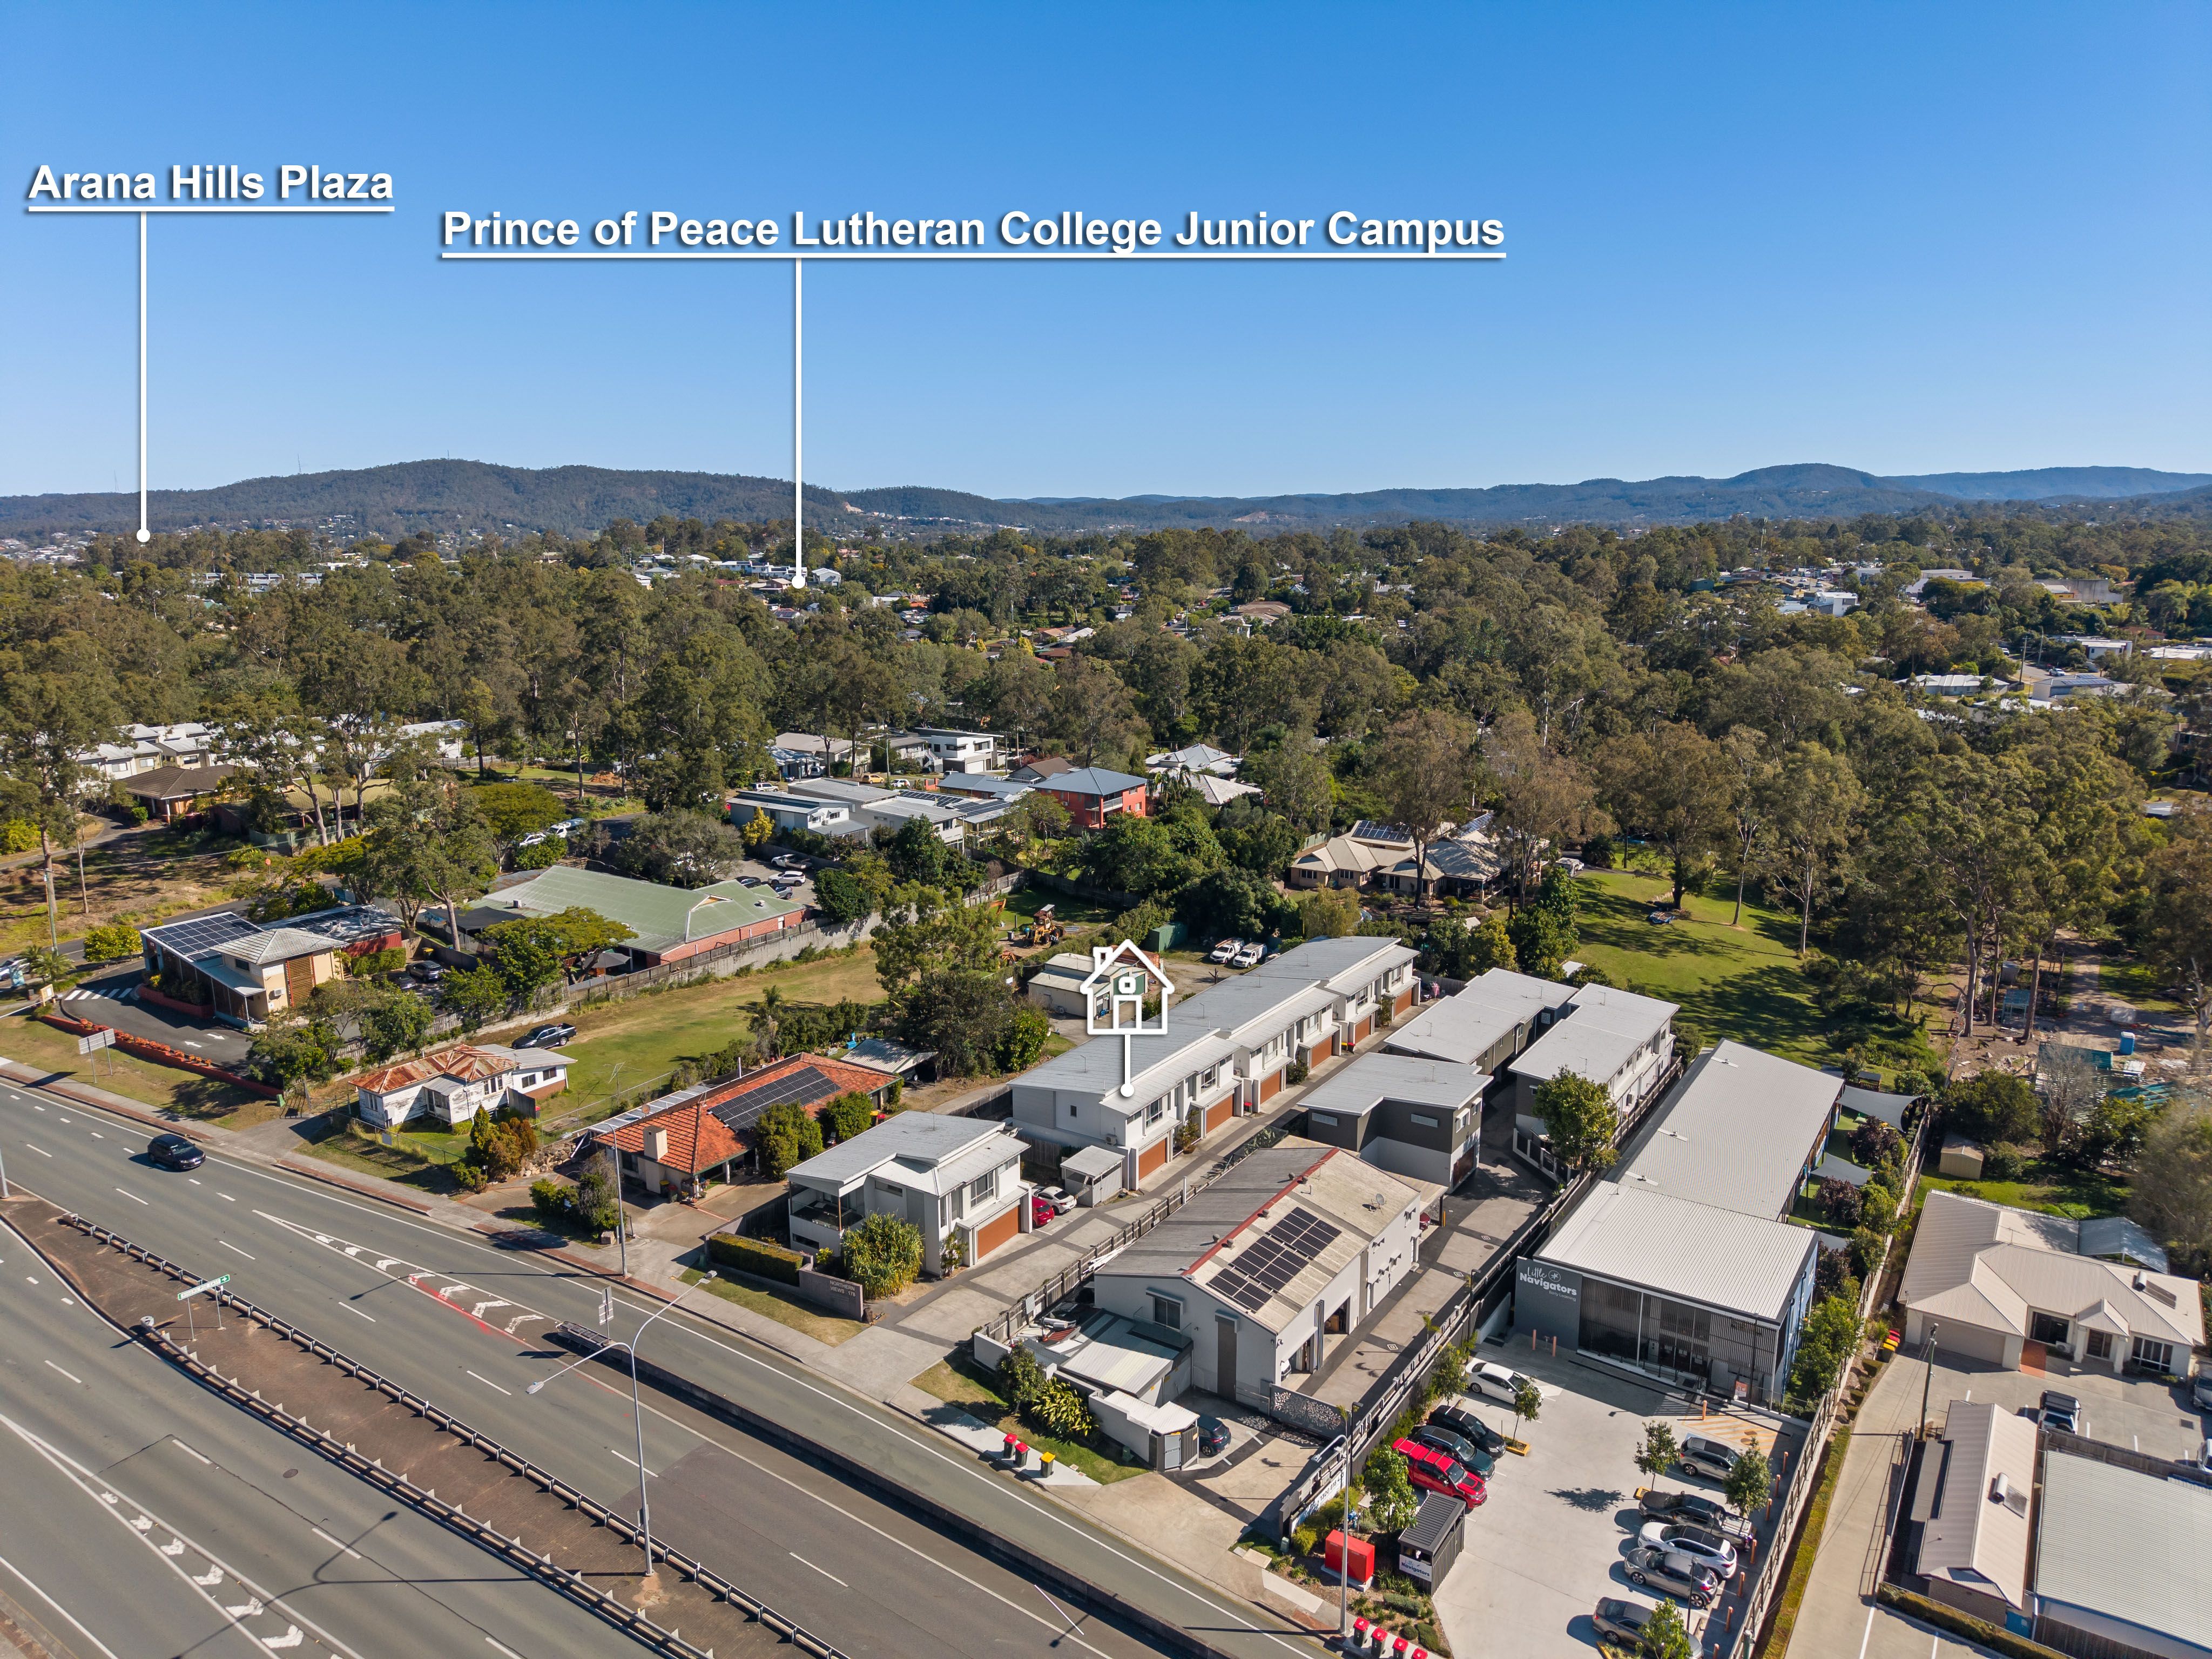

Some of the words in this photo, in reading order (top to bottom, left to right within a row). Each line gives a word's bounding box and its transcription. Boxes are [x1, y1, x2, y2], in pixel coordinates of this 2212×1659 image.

[1527, 1266, 1547, 1278] Little
[830, 1280, 855, 1291] NORTHERN
[830, 1285, 845, 1294] VIEWS
[1520, 1272, 1577, 1296] Navigators
[1401, 1562, 1430, 1576] Navigators
